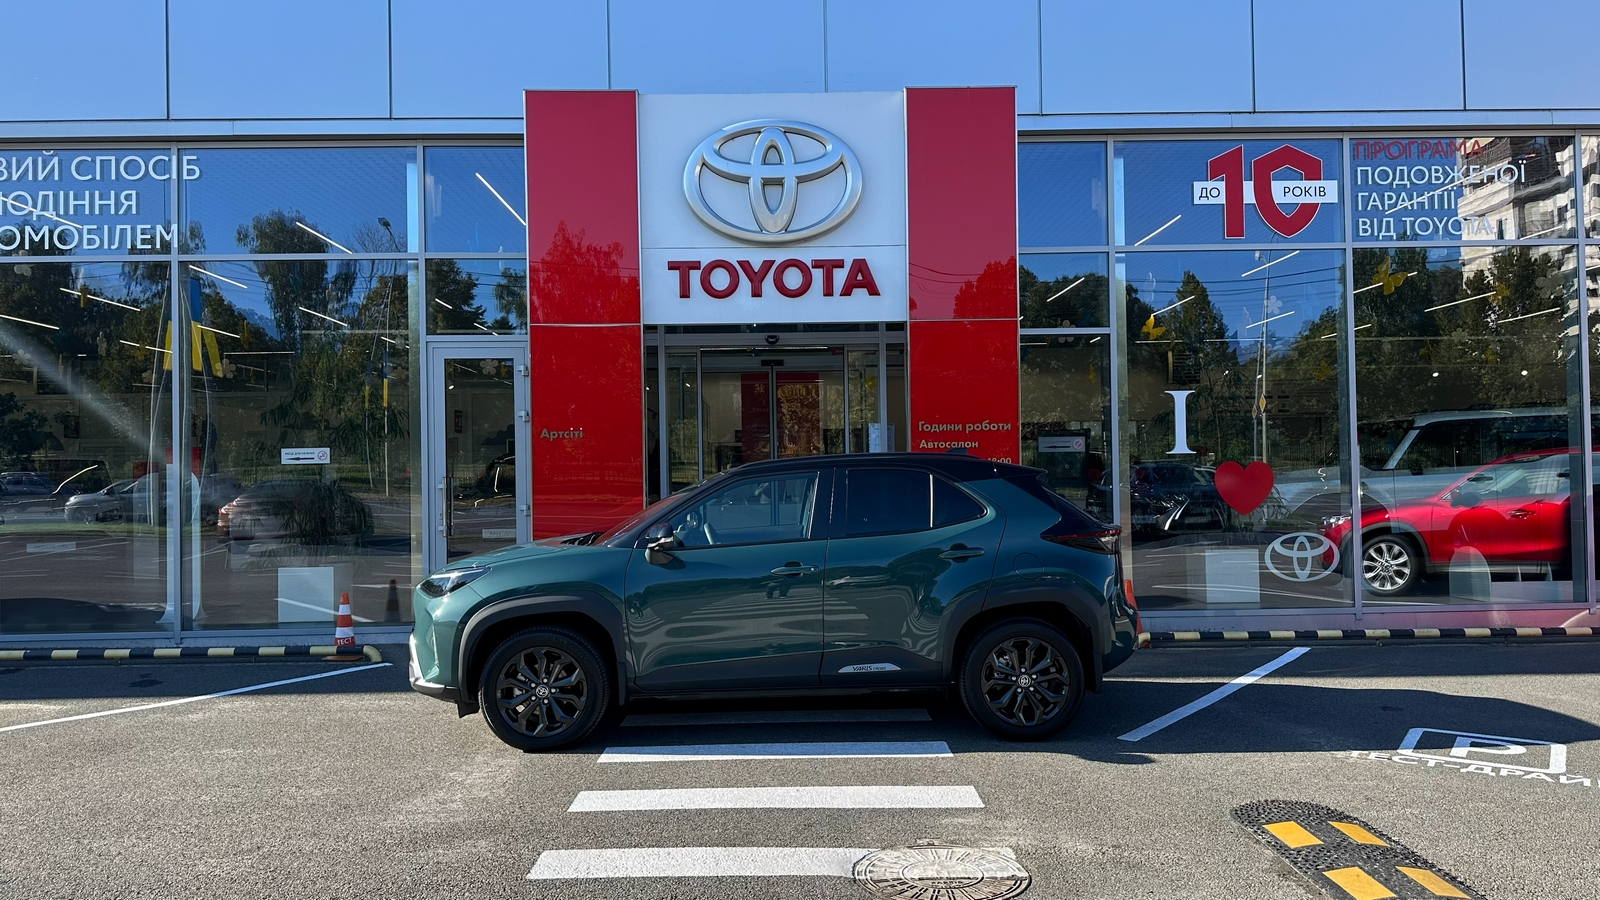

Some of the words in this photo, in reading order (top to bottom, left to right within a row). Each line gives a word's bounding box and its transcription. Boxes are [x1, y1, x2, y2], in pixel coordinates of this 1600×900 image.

[1354, 140, 1485, 160] ПРОГРАМА
[71, 155, 200, 181] СПОСІБ
[1357, 160, 1527, 188] ПОДОВЖЕНОЇ
[1199, 187, 1220, 200] ДО
[1208, 144, 1323, 239] 10
[1283, 186, 1327, 198] РОКІВ
[1357, 187, 1455, 211] ГАРАНТІЇ
[0, 190, 137, 221] ОДІННЯ
[0, 223, 178, 250] ОМОБІЛЕМ
[1358, 217, 1396, 240] ВІД
[1402, 216, 1494, 236] TOYOTA
[667, 258, 881, 299] TOYOTA
[540, 427, 583, 441] Артсіті
[918, 421, 962, 432] Години
[966, 420, 1011, 433] роботи
[1164, 390, 1197, 454] I
[919, 440, 979, 449] Автосалон
[1350, 750, 1600, 787] ТЕСТ-ДРАЙ
